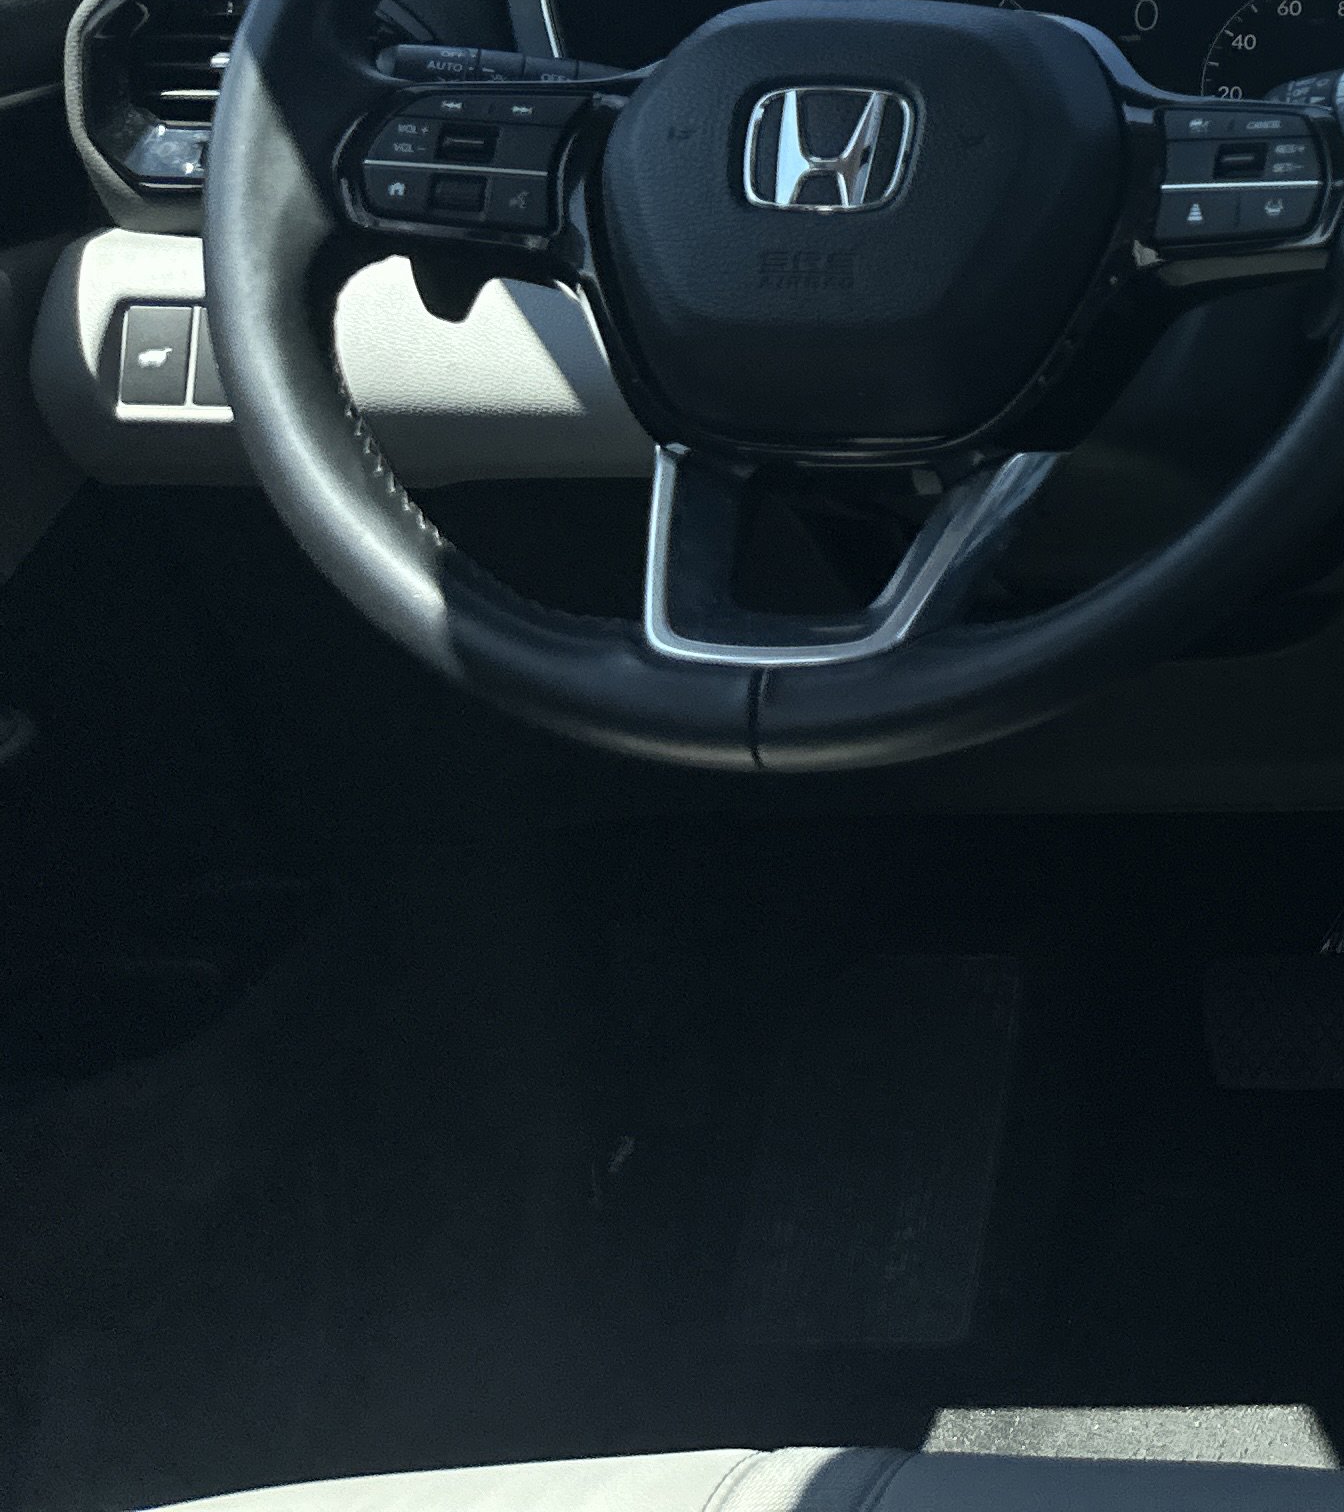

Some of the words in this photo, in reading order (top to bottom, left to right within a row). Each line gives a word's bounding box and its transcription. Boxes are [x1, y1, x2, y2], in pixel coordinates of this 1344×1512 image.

[1276, 0, 1303, 18] 60
[1231, 35, 1257, 51] 40
[426, 60, 464, 73] AUTO
[1217, 86, 1244, 100] 20
